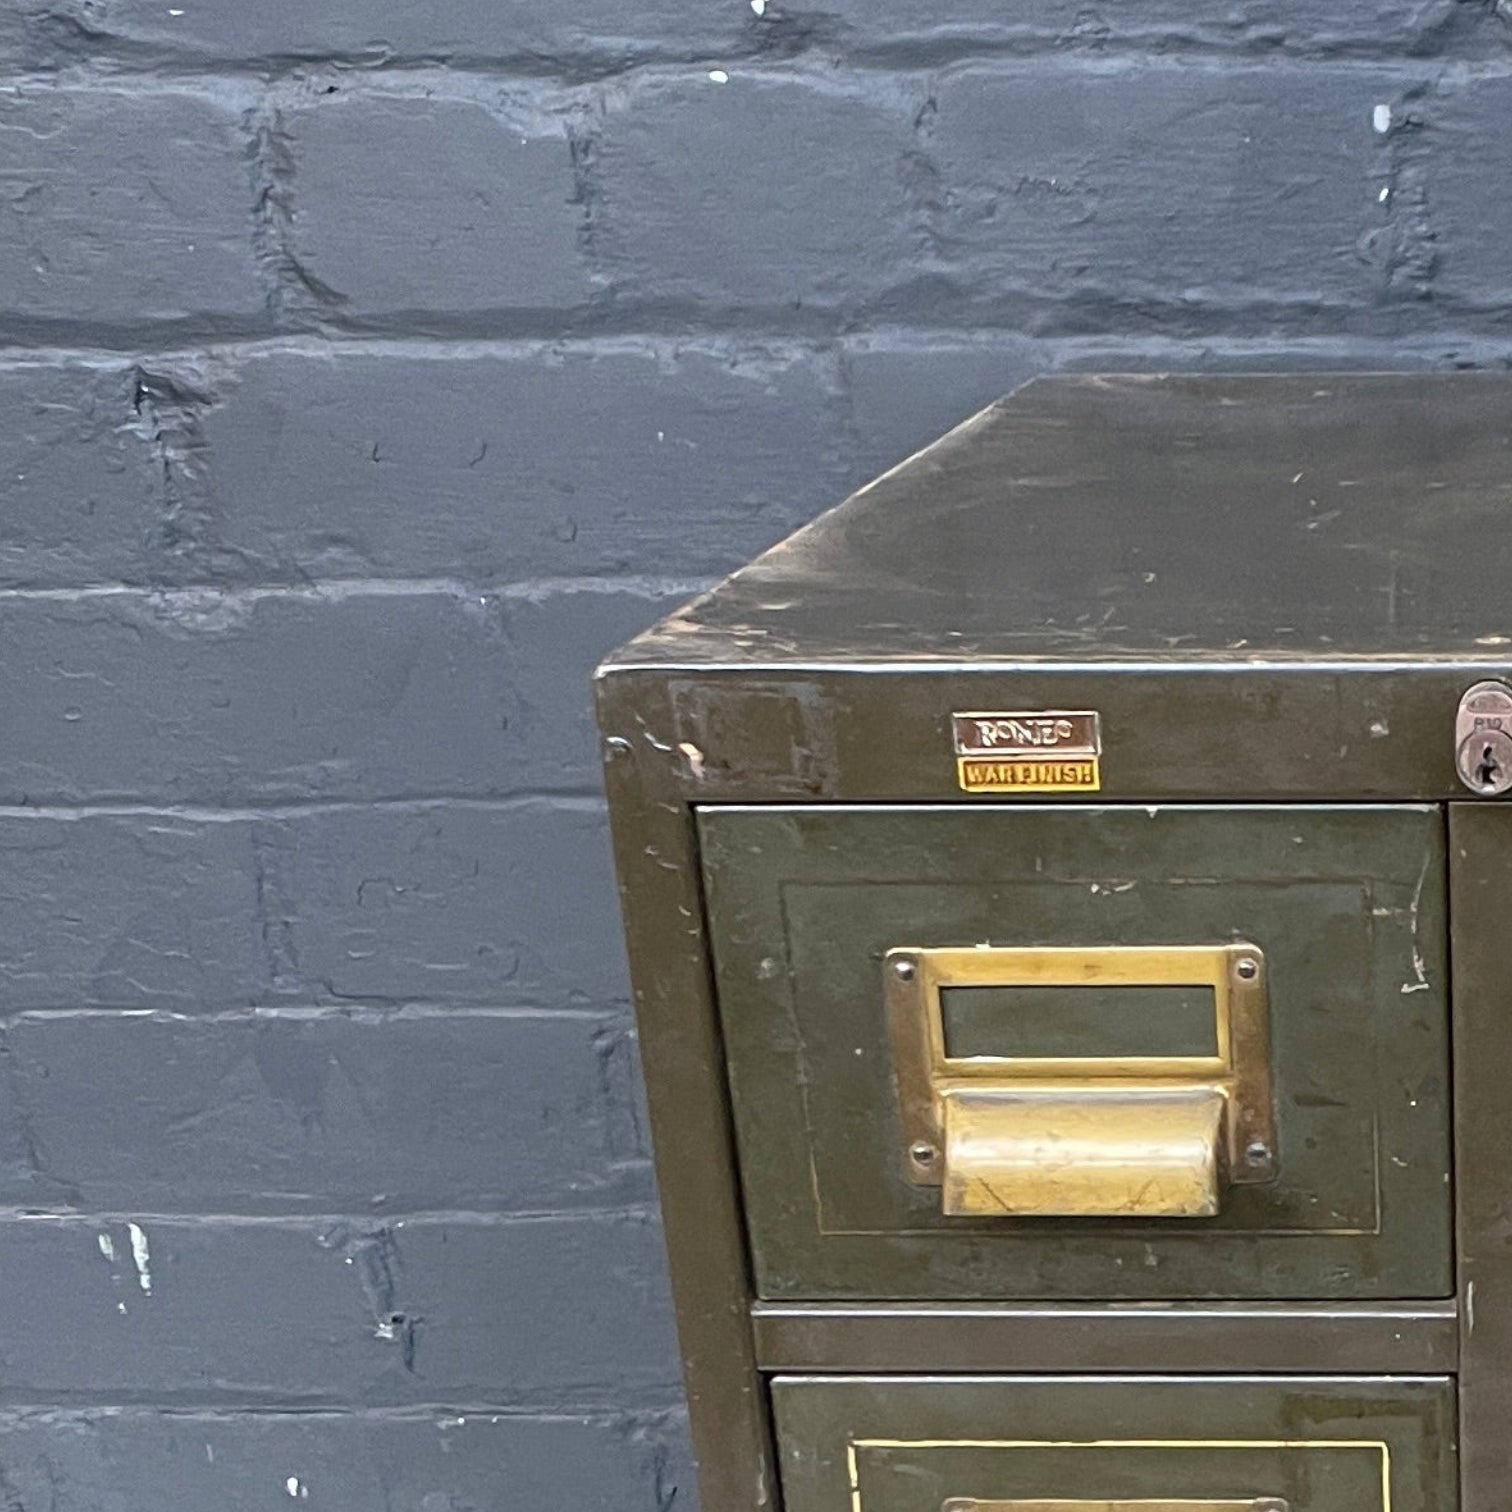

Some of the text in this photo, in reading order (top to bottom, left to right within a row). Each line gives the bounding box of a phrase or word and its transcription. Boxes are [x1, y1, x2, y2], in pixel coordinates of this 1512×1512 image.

[974, 719, 1073, 746] RONEO
[966, 764, 1091, 782] WAR FINISH
